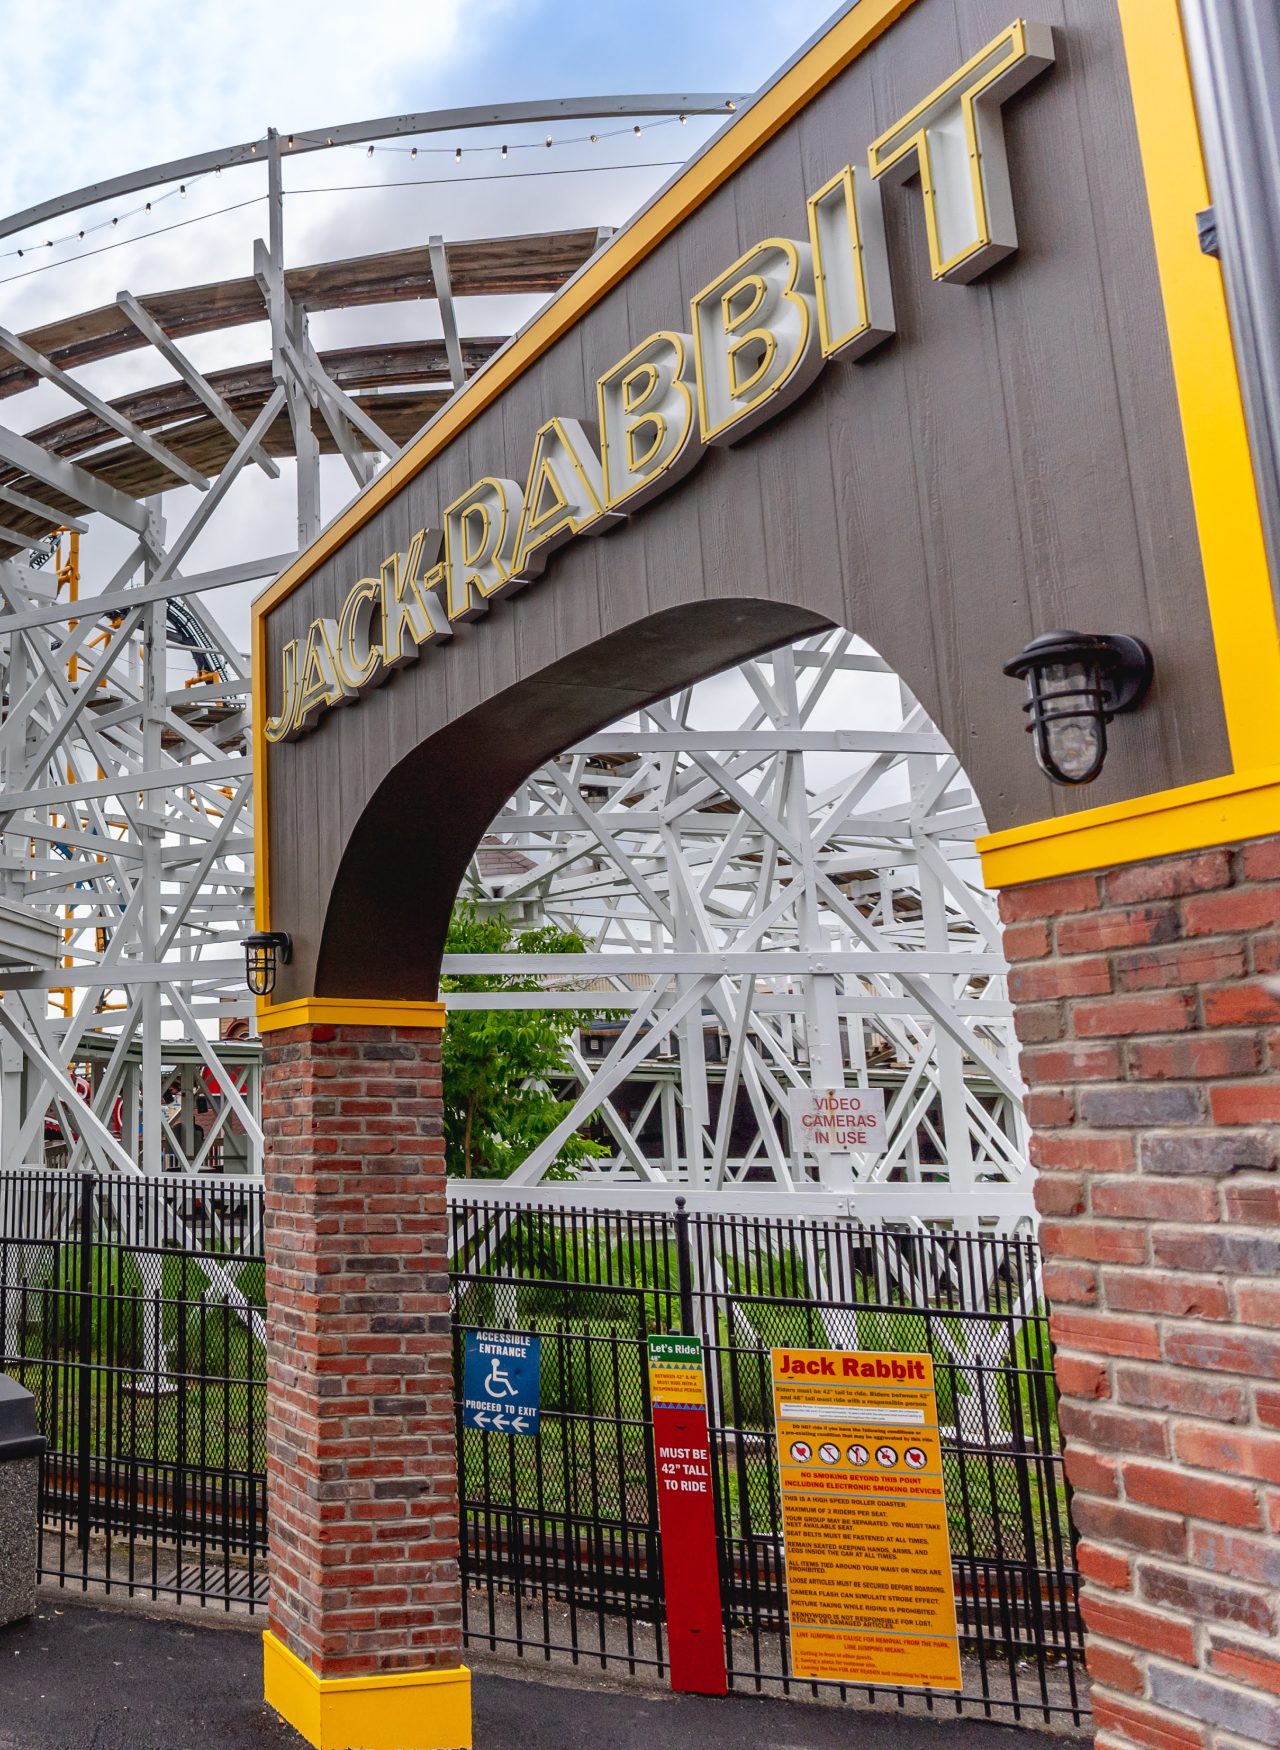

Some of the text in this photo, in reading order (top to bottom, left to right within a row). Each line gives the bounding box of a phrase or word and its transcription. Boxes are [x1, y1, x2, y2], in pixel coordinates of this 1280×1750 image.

[814, 1098, 861, 1111] VIDEO
[802, 1114, 877, 1128] CAMERAS
[815, 1131, 867, 1144] IN USE
[476, 1331, 531, 1346] ACCESSIBLE
[479, 1343, 527, 1358] ENTRANCE
[650, 1343, 700, 1355] Let's Ride!
[779, 1354, 925, 1379] Jack Rabbit
[466, 1400, 537, 1417] PROCEED TO EXIT
[660, 1447, 708, 1460] MUST BE
[683, 1465, 708, 1476] TALL
[664, 1480, 707, 1493] TO RIDE
[784, 1480, 824, 1488] INCLUDING
[826, 1482, 870, 1490] ELECTRONIC
[792, 1611, 831, 1619] KENNYWOOD
[855, 1615, 898, 1624] RESPONSIBLE
